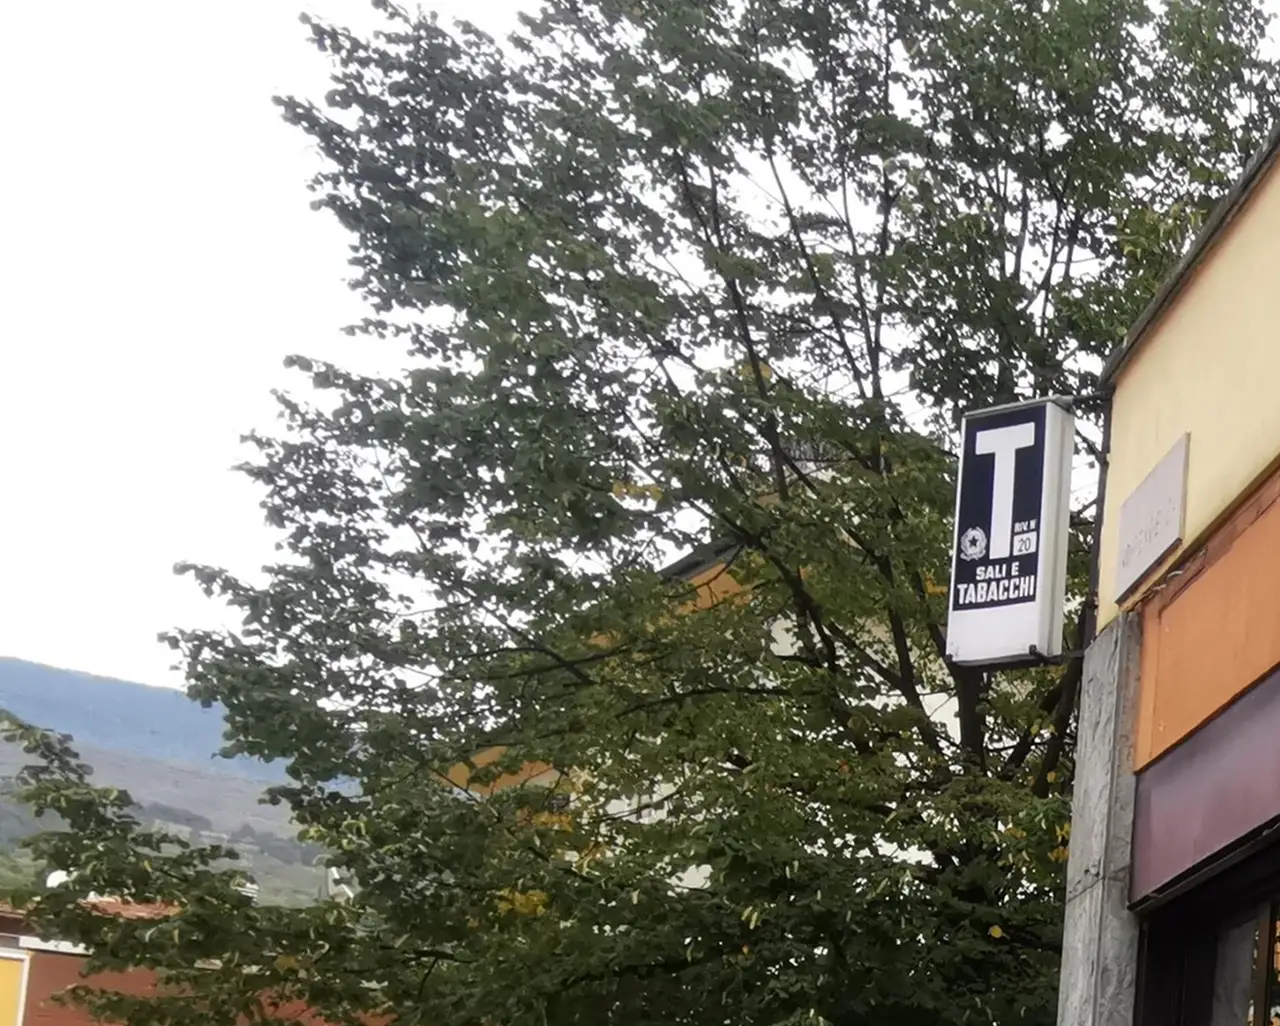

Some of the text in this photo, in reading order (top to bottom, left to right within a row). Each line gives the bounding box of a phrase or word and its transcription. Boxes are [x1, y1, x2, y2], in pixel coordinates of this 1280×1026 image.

[975, 421, 1036, 560] T
[1018, 538, 1031, 553] 20
[975, 562, 1020, 581] SALI E
[957, 575, 1036, 605] TABACCHI
